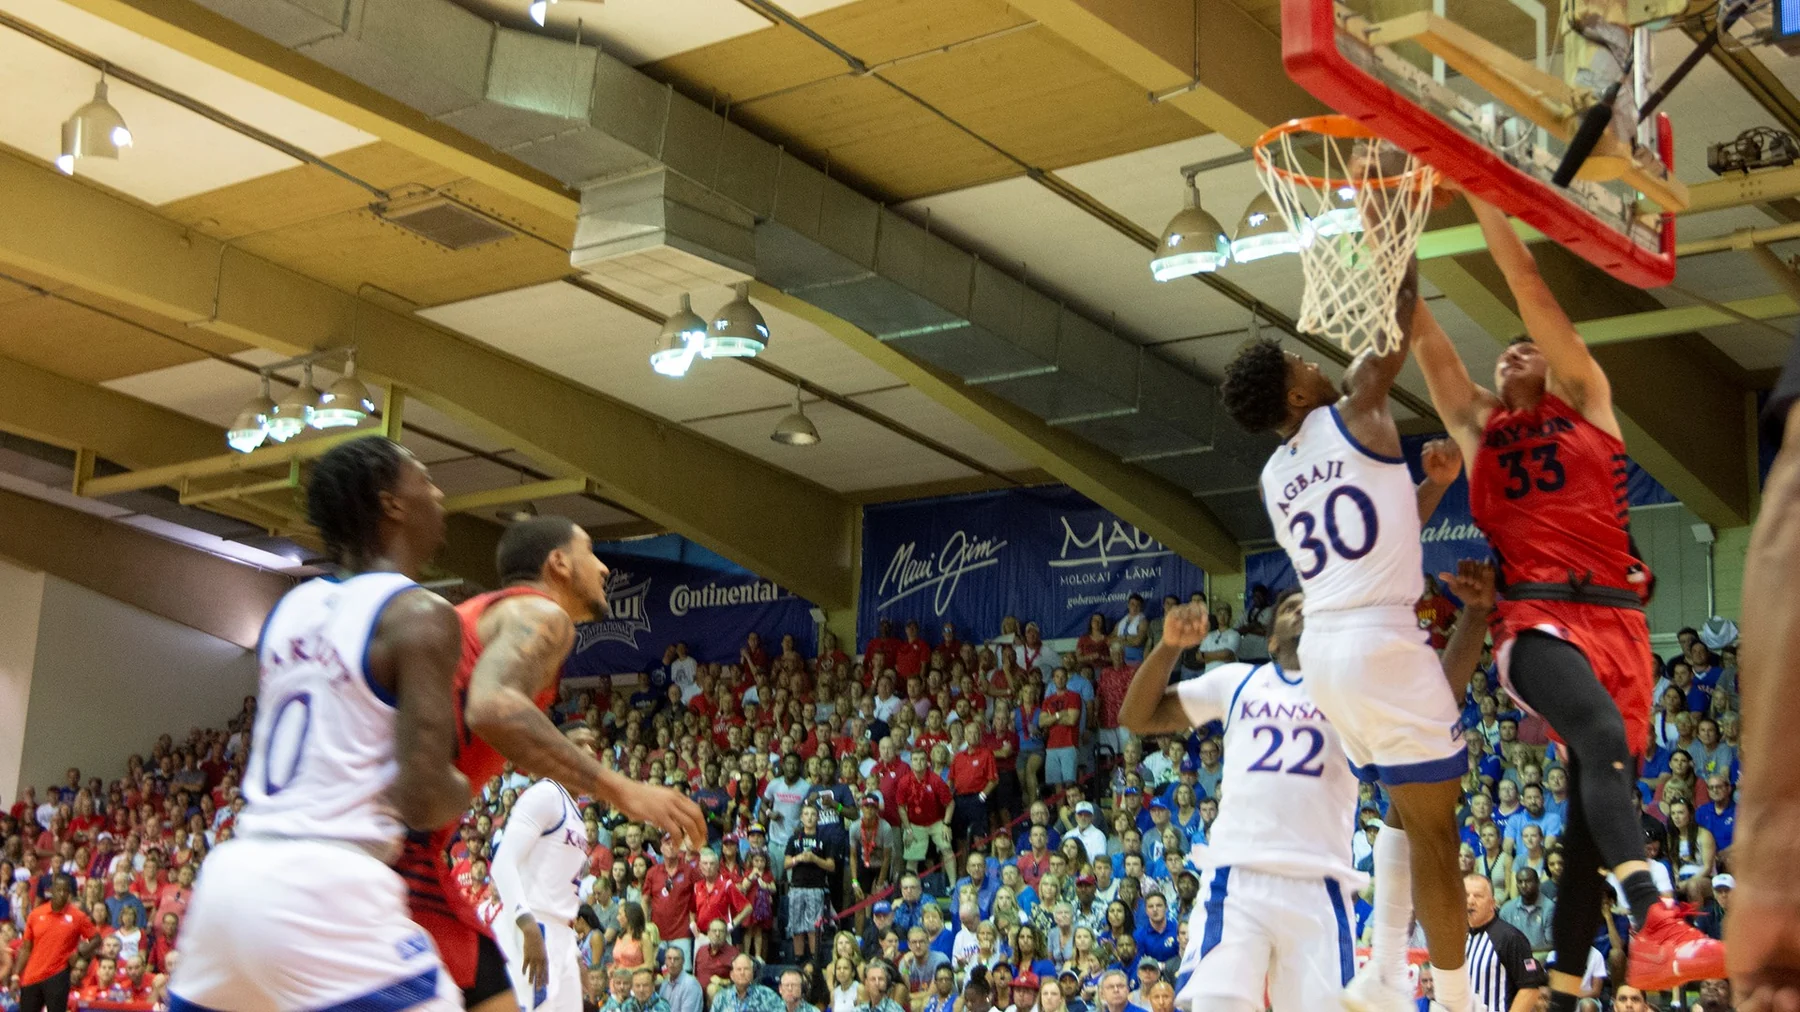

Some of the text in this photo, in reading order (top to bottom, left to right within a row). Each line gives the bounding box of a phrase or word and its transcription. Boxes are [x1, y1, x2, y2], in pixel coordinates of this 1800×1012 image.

[1277, 460, 1344, 518] AGBAJI
[1498, 442, 1566, 499] 33
[1289, 485, 1379, 580] 30
[669, 580, 779, 617] Continental
[879, 531, 1007, 616] Maui Jim
[264, 691, 313, 796] 0
[1246, 725, 1325, 777] 22
